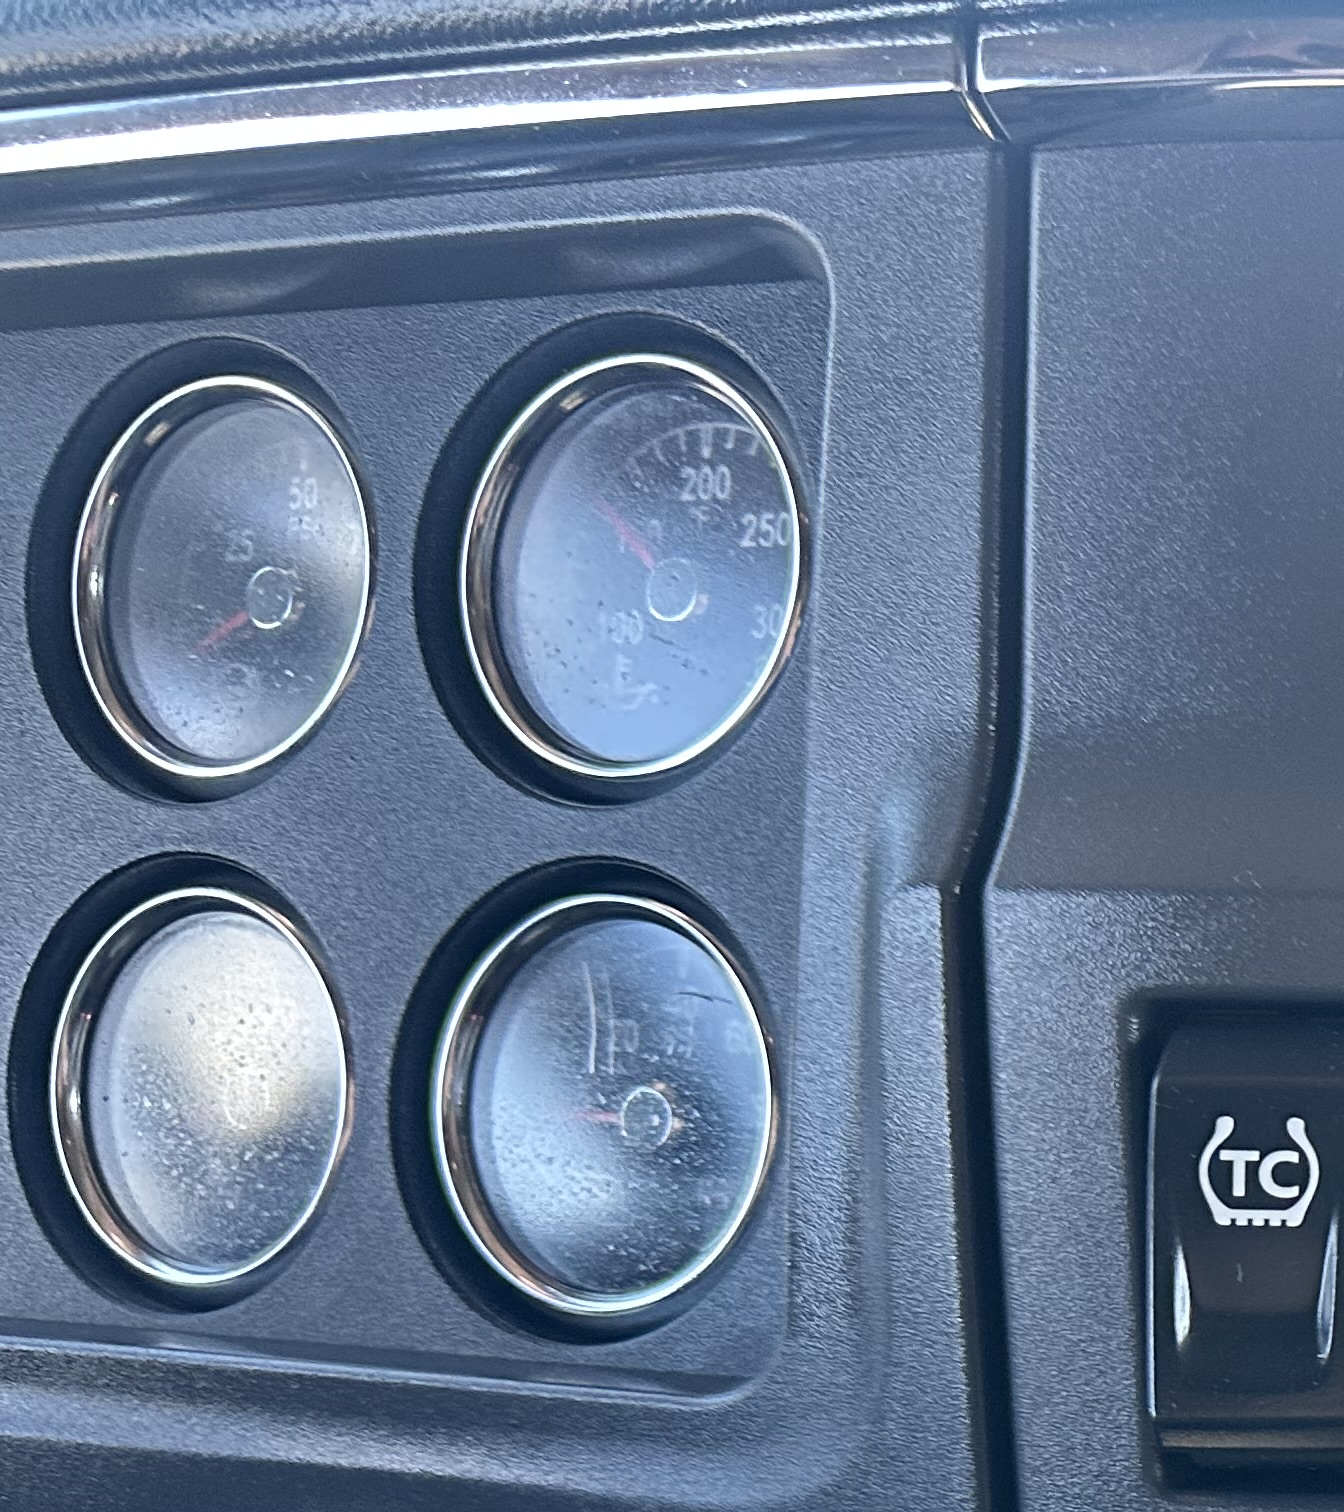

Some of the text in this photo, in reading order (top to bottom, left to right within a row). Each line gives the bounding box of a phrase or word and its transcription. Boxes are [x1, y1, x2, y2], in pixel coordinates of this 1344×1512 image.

[679, 464, 731, 501] 200
[739, 512, 790, 548] 250
[1219, 1150, 1300, 1198] TC
